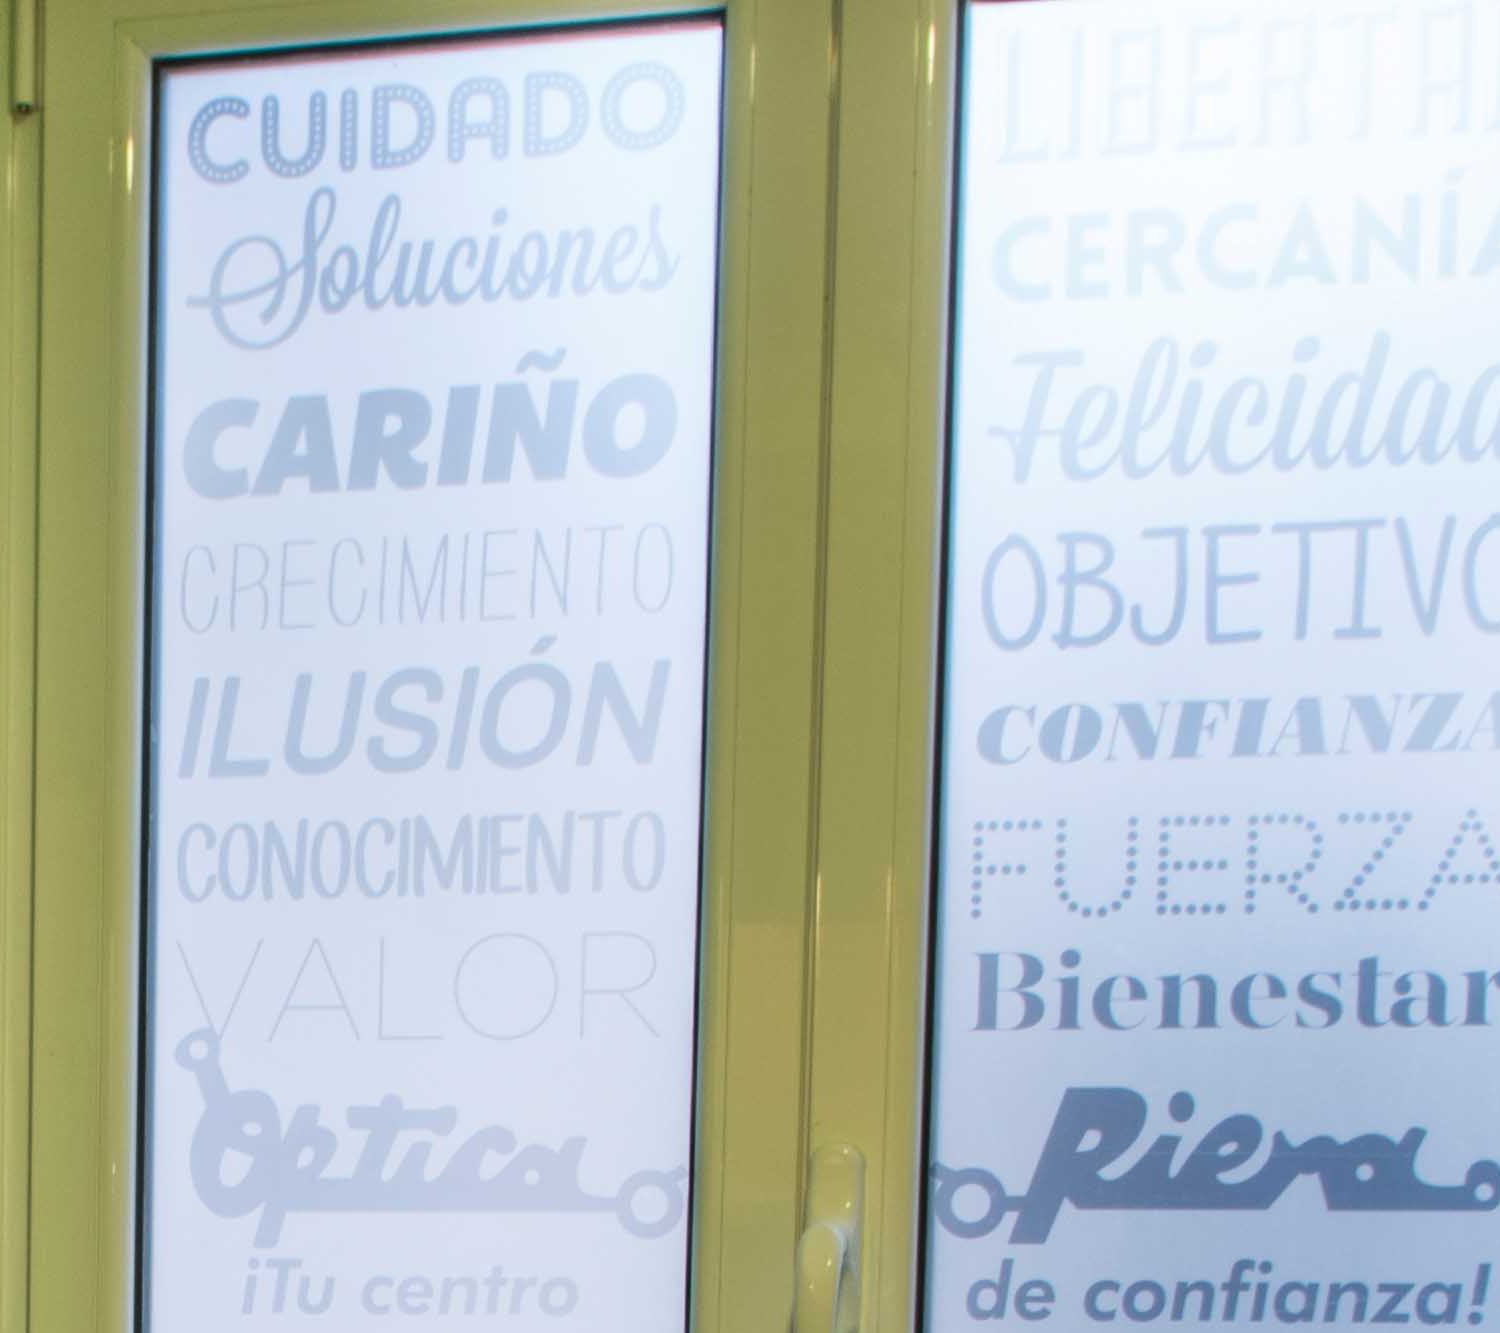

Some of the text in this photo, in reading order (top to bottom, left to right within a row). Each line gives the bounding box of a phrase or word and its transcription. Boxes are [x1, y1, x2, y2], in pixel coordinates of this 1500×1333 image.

[186, 60, 687, 185] CUIDADO
[186, 186, 681, 350] Soluciones
[181, 347, 679, 501] CARIÑO
[179, 522, 676, 635] CRECIMIENTO
[177, 635, 673, 781] ILUSIÓN
[176, 809, 667, 903] CONOCIMIENTO
[175, 931, 661, 1043] VALOR
[361, 1265, 580, 1317] centro
[965, 1258, 1493, 1326] de confianza!
